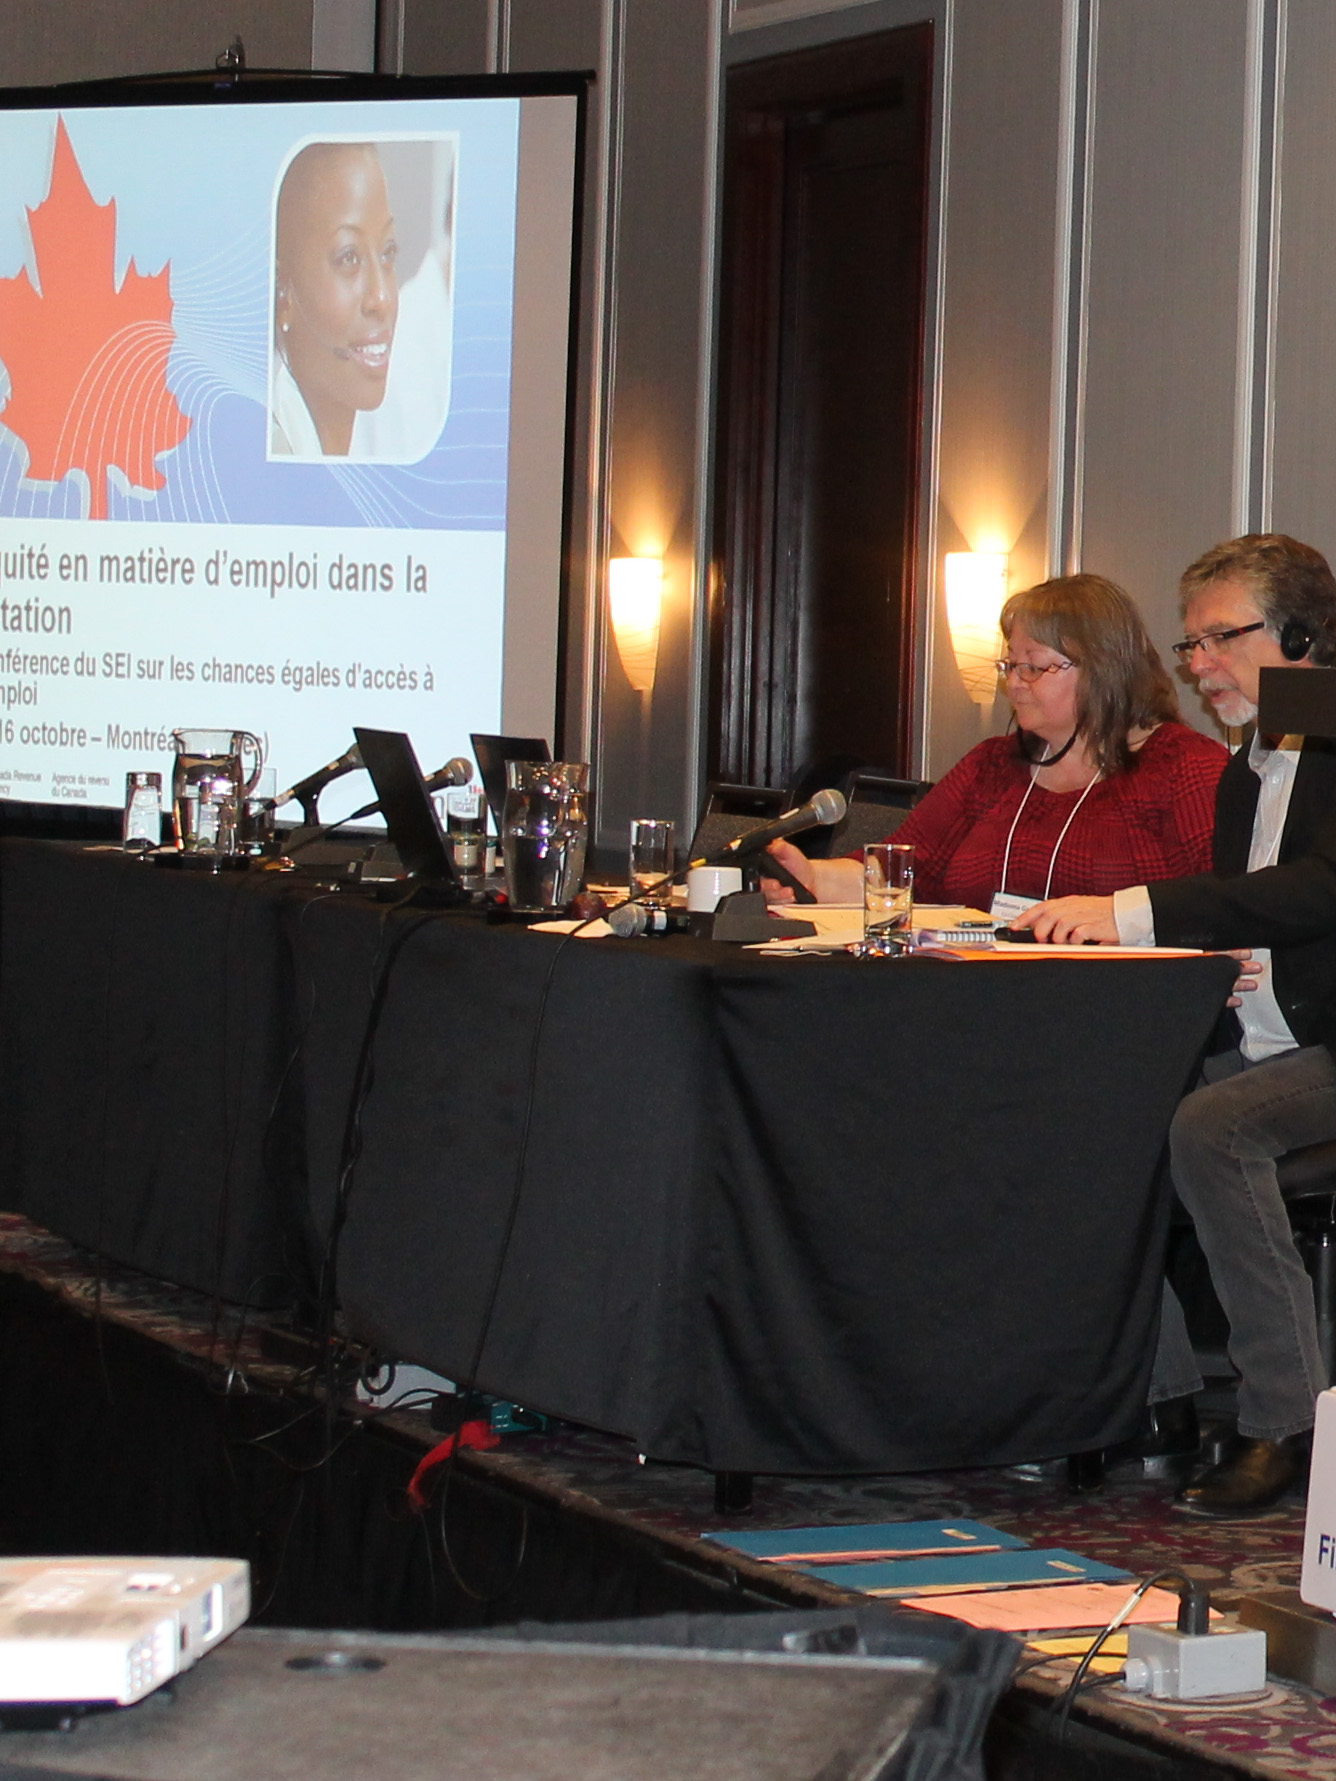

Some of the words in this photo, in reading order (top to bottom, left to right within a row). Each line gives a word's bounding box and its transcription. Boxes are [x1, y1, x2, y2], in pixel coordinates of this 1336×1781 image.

[0, 543, 49, 586] uité
[58, 552, 88, 582] en
[98, 547, 195, 586] matière
[328, 553, 394, 592] dans
[406, 555, 428, 593] la
[0, 597, 72, 634] tation
[74, 651, 96, 677] du
[102, 652, 131, 679] SEI
[136, 658, 165, 680] sur
[170, 655, 195, 681] les
[201, 657, 275, 685] chances
[281, 659, 341, 692] égales
[423, 664, 434, 691] à
[20, 721, 87, 748] octobre
[107, 724, 181, 752] Montréa
[61, 786, 87, 798] Canada
